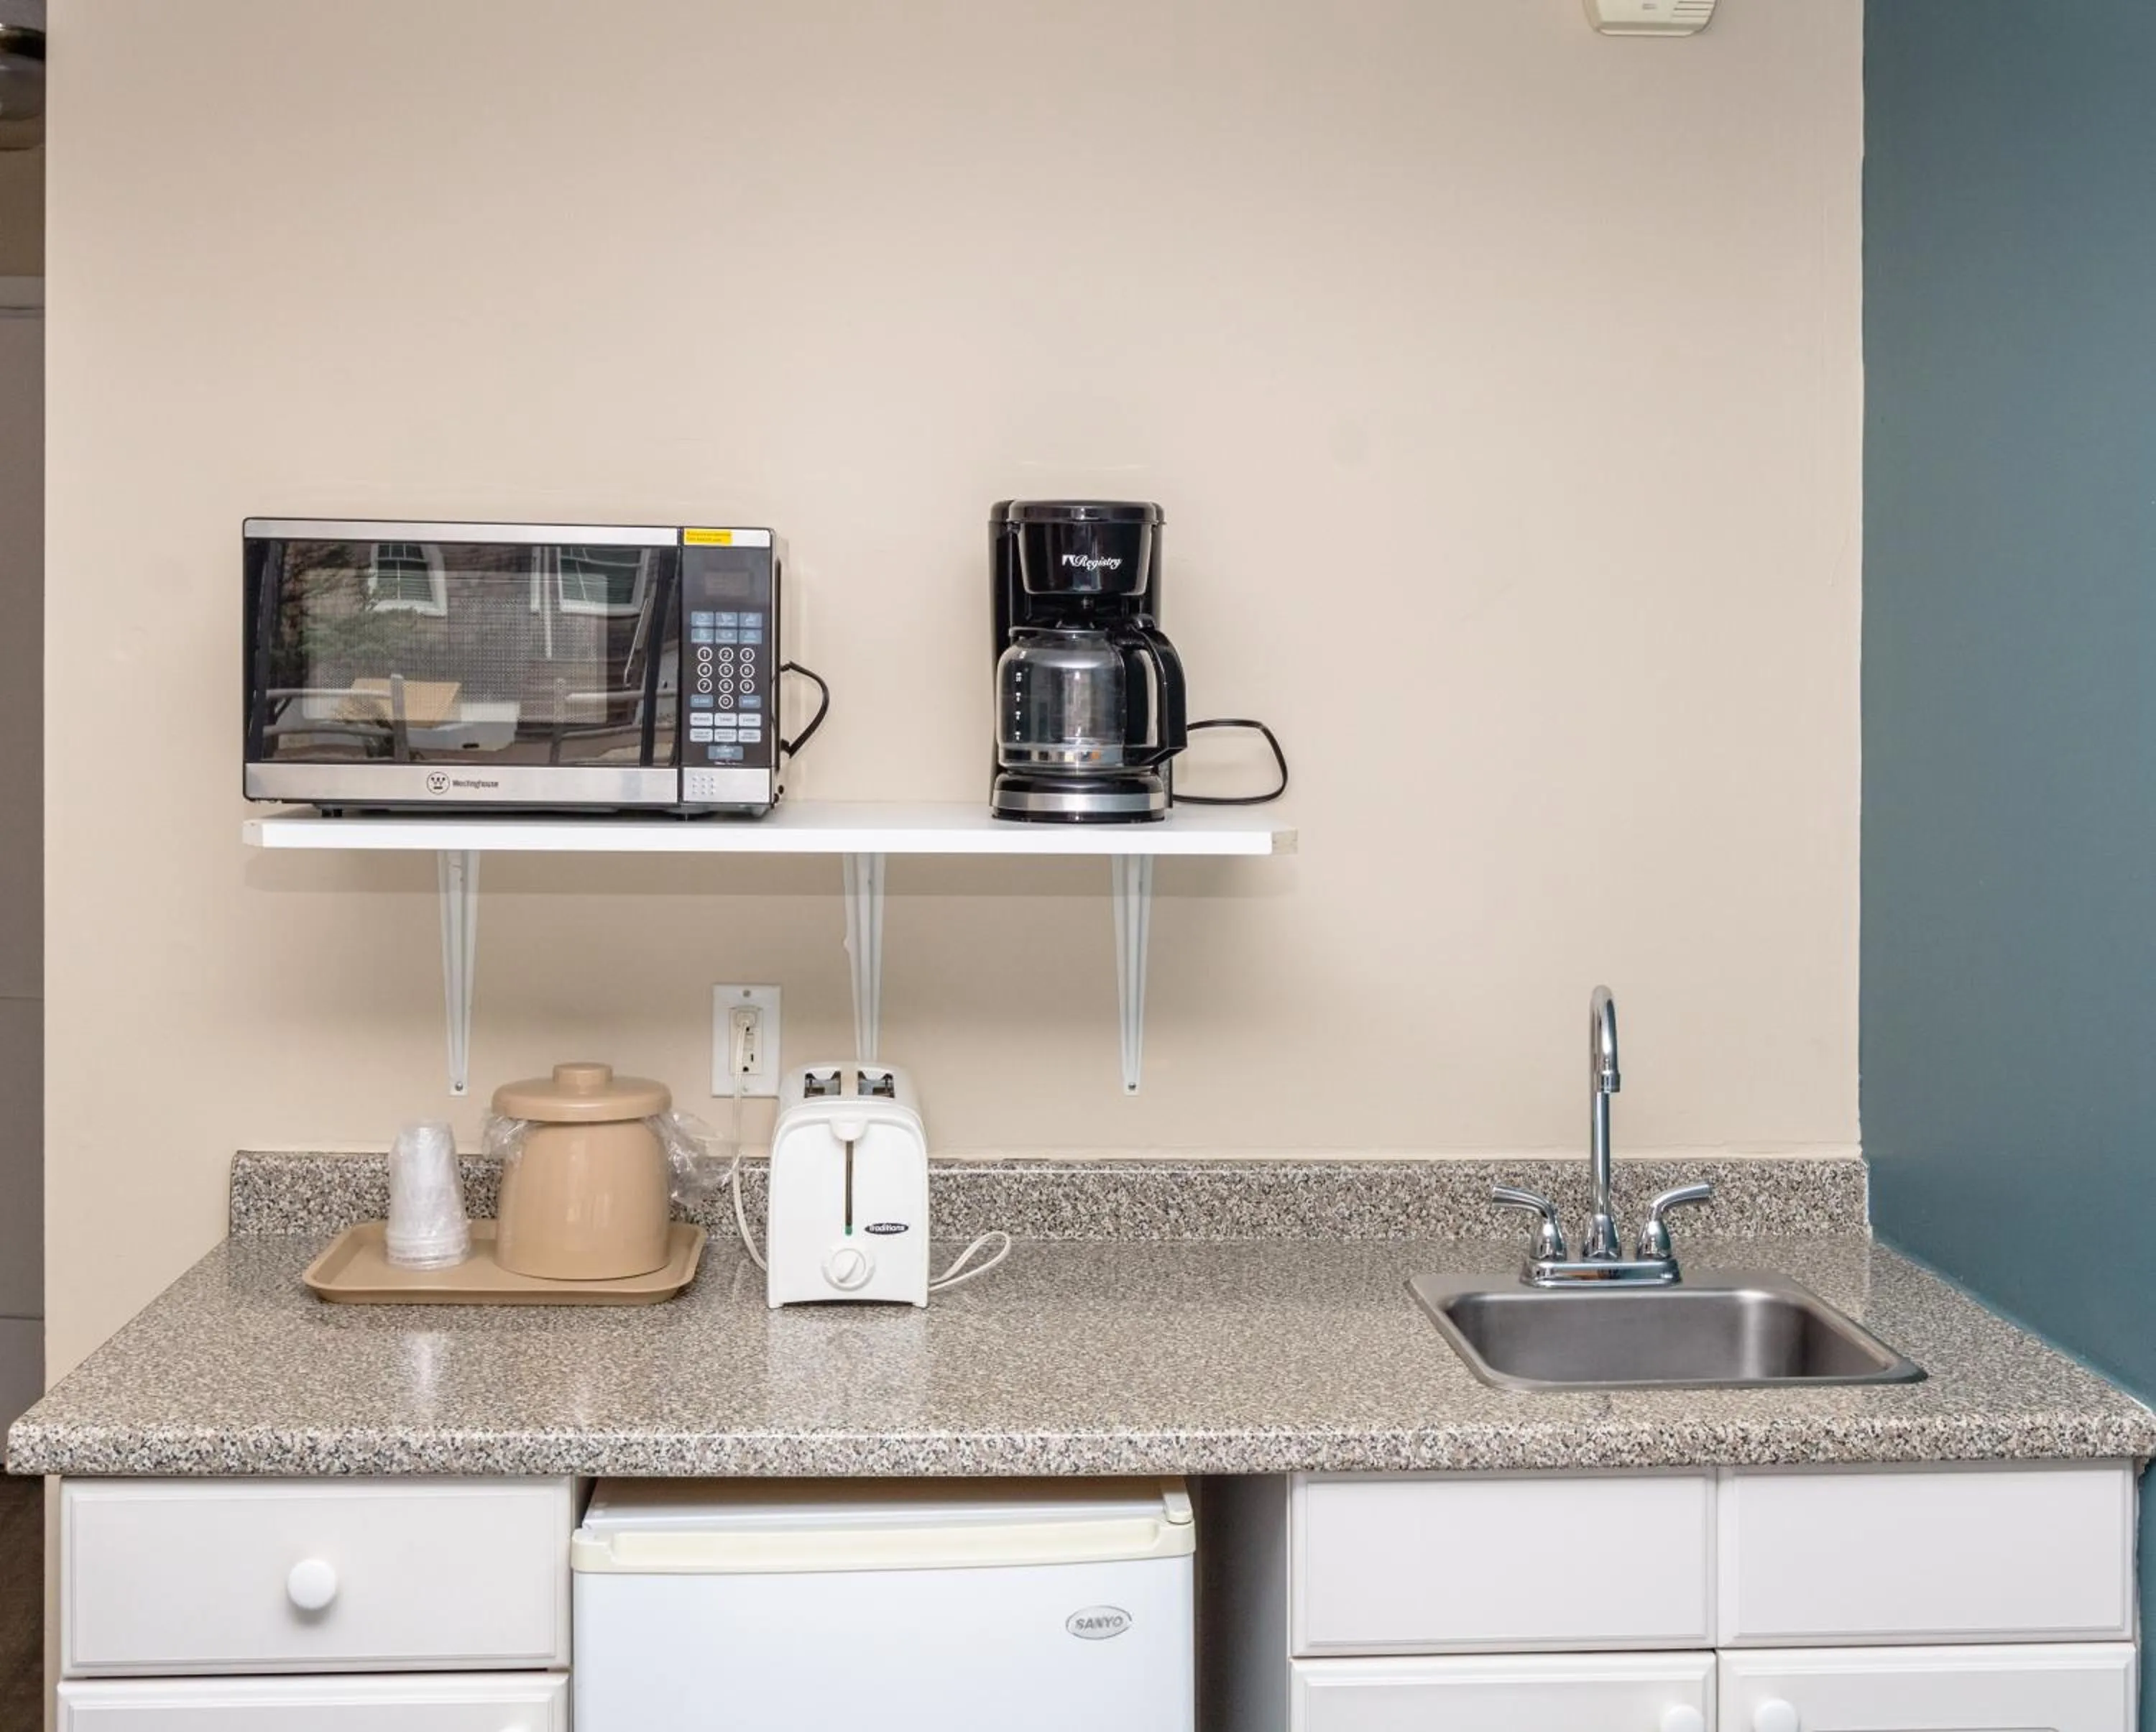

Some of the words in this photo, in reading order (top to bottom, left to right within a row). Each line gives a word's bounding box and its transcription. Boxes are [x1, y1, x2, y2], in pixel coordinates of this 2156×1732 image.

[1074, 554, 1123, 571] Registry
[453, 779, 499, 790] Westinghouse
[1075, 1615, 1123, 1631] SANYO
